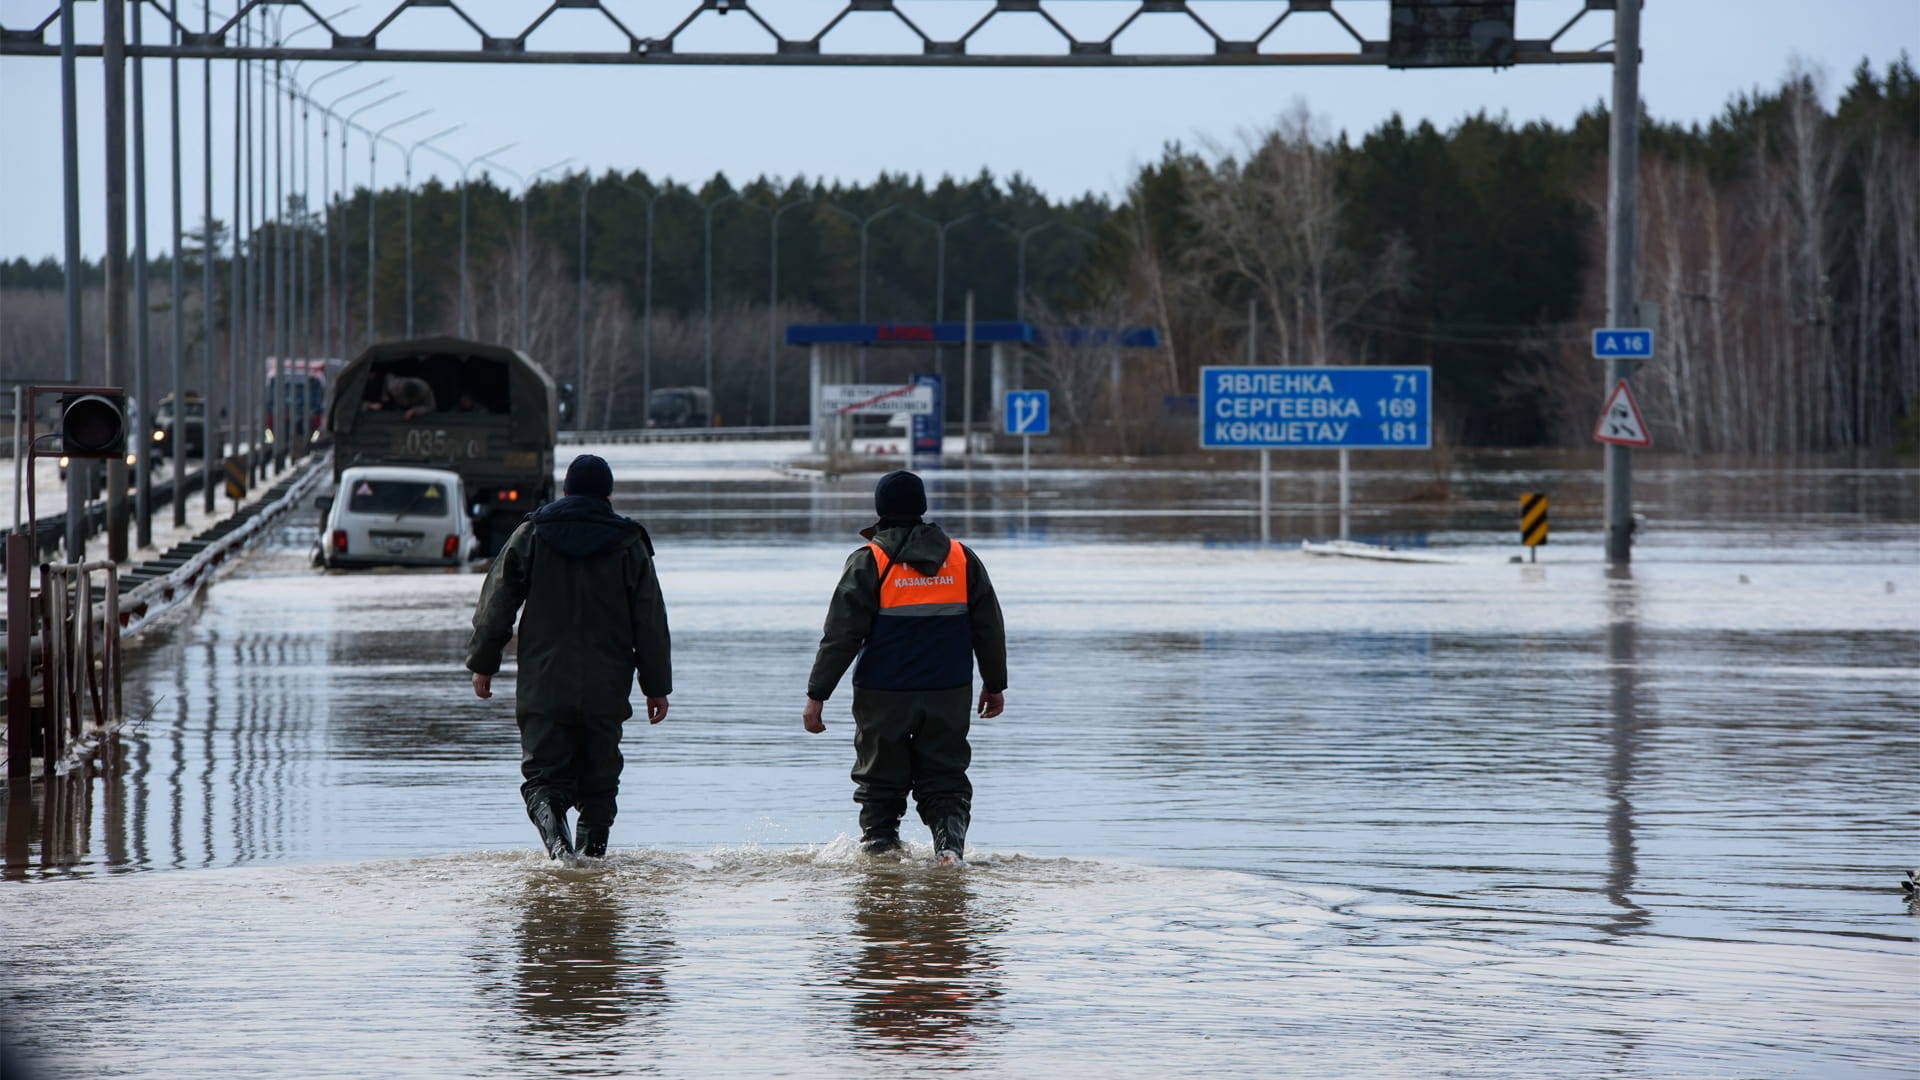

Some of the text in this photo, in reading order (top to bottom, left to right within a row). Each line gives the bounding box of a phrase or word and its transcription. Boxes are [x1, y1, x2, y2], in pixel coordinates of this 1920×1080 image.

[1623, 336, 1643, 351] 16
[1217, 374, 1417, 393] ЯВЛЕНКА 71
[1216, 398, 1417, 418] СЕРГЕЕВКА 169
[1215, 422, 1417, 442] КӨКШЕТАУ 181
